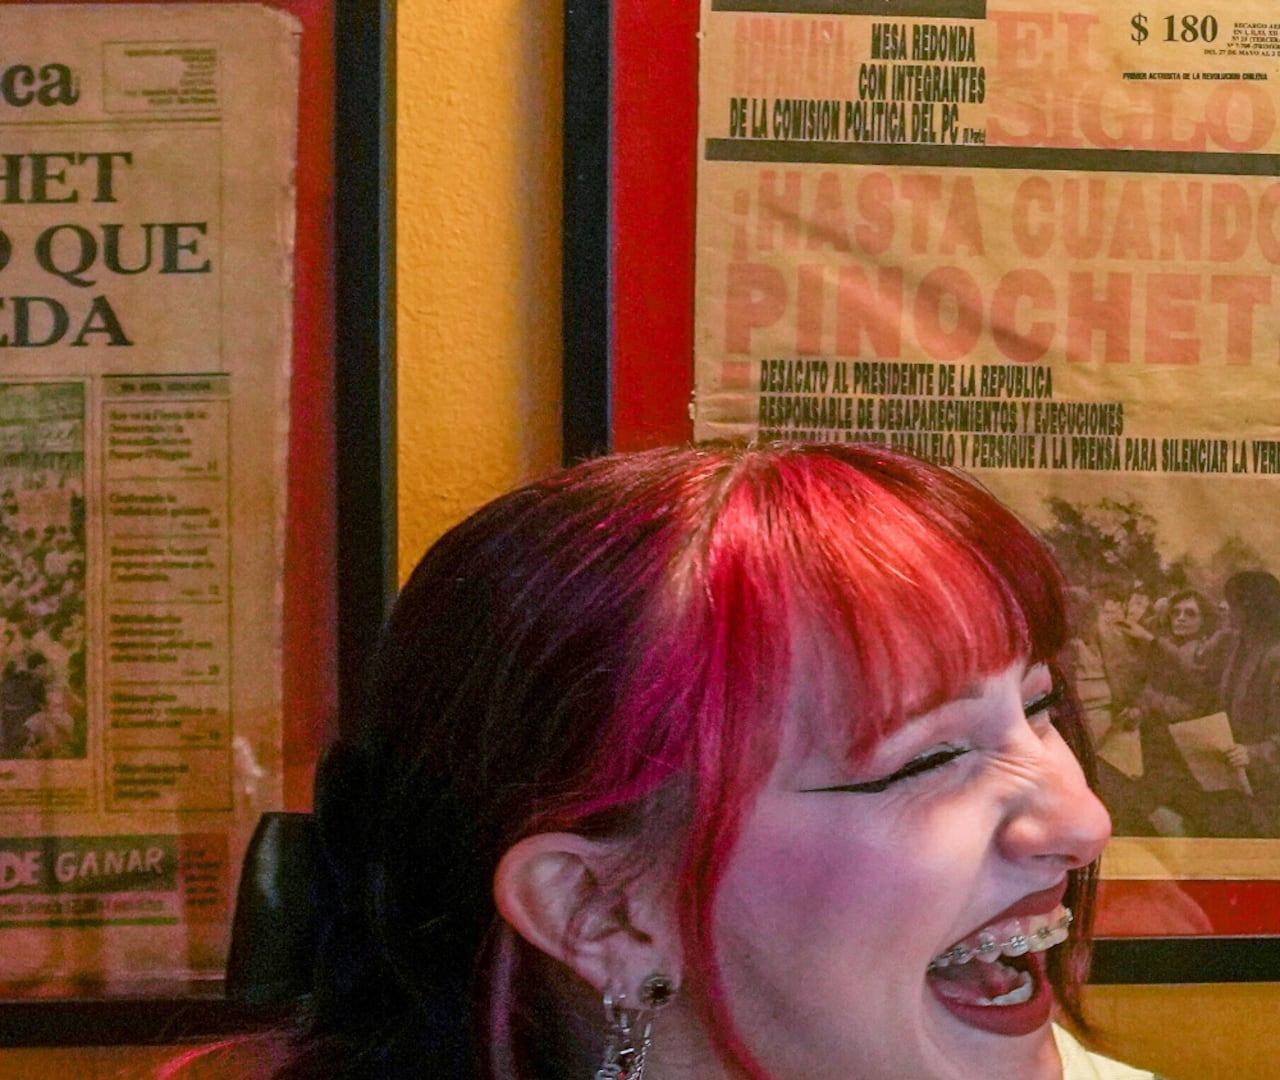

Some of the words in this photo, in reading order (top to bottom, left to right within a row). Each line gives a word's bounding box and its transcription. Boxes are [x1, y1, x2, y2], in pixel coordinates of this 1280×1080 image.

[871, 23, 907, 60] MESA
[912, 25, 976, 62] REDONDA
[987, 10, 1101, 73] EL
[1131, 12, 1148, 45] $
[1163, 14, 1218, 43] 180
[1, 63, 80, 107] ca
[858, 63, 887, 101] CON
[891, 65, 986, 104] INTEGRANTES
[730, 97, 748, 138] DE
[752, 98, 768, 138] LA
[773, 99, 840, 141] COMISION
[845, 101, 906, 142] POLITICA
[911, 103, 936, 143] DEL
[941, 104, 960, 143] PC
[986, 80, 1276, 150] SIGLO
[35, 222, 211, 288] QUE
[760, 359, 828, 394] DESACATO
[832, 361, 849, 394] AL
[853, 362, 934, 397] PRESIDENTE
[938, 364, 955, 396] DE
[960, 364, 976, 397] LA
[980, 365, 1052, 399] REPUBLICA
[759, 395, 852, 429] RESPONSABLE
[857, 398, 875, 430] DE
[878, 399, 1018, 433] DESAPARECIMIENTOS
[1022, 402, 1031, 433] Y
[1034, 402, 1124, 436] EJECUCIONES
[960, 434, 968, 467] Y
[972, 435, 1035, 469] PERSIGUE
[1039, 437, 1048, 469] A
[1052, 437, 1067, 469] LA
[1071, 437, 1121, 471] PRENSA
[1125, 438, 1157, 472] PARA
[1161, 438, 1228, 473] SILENCIAR
[1232, 440, 1248, 473] LA
[54, 846, 165, 883] GANAR
